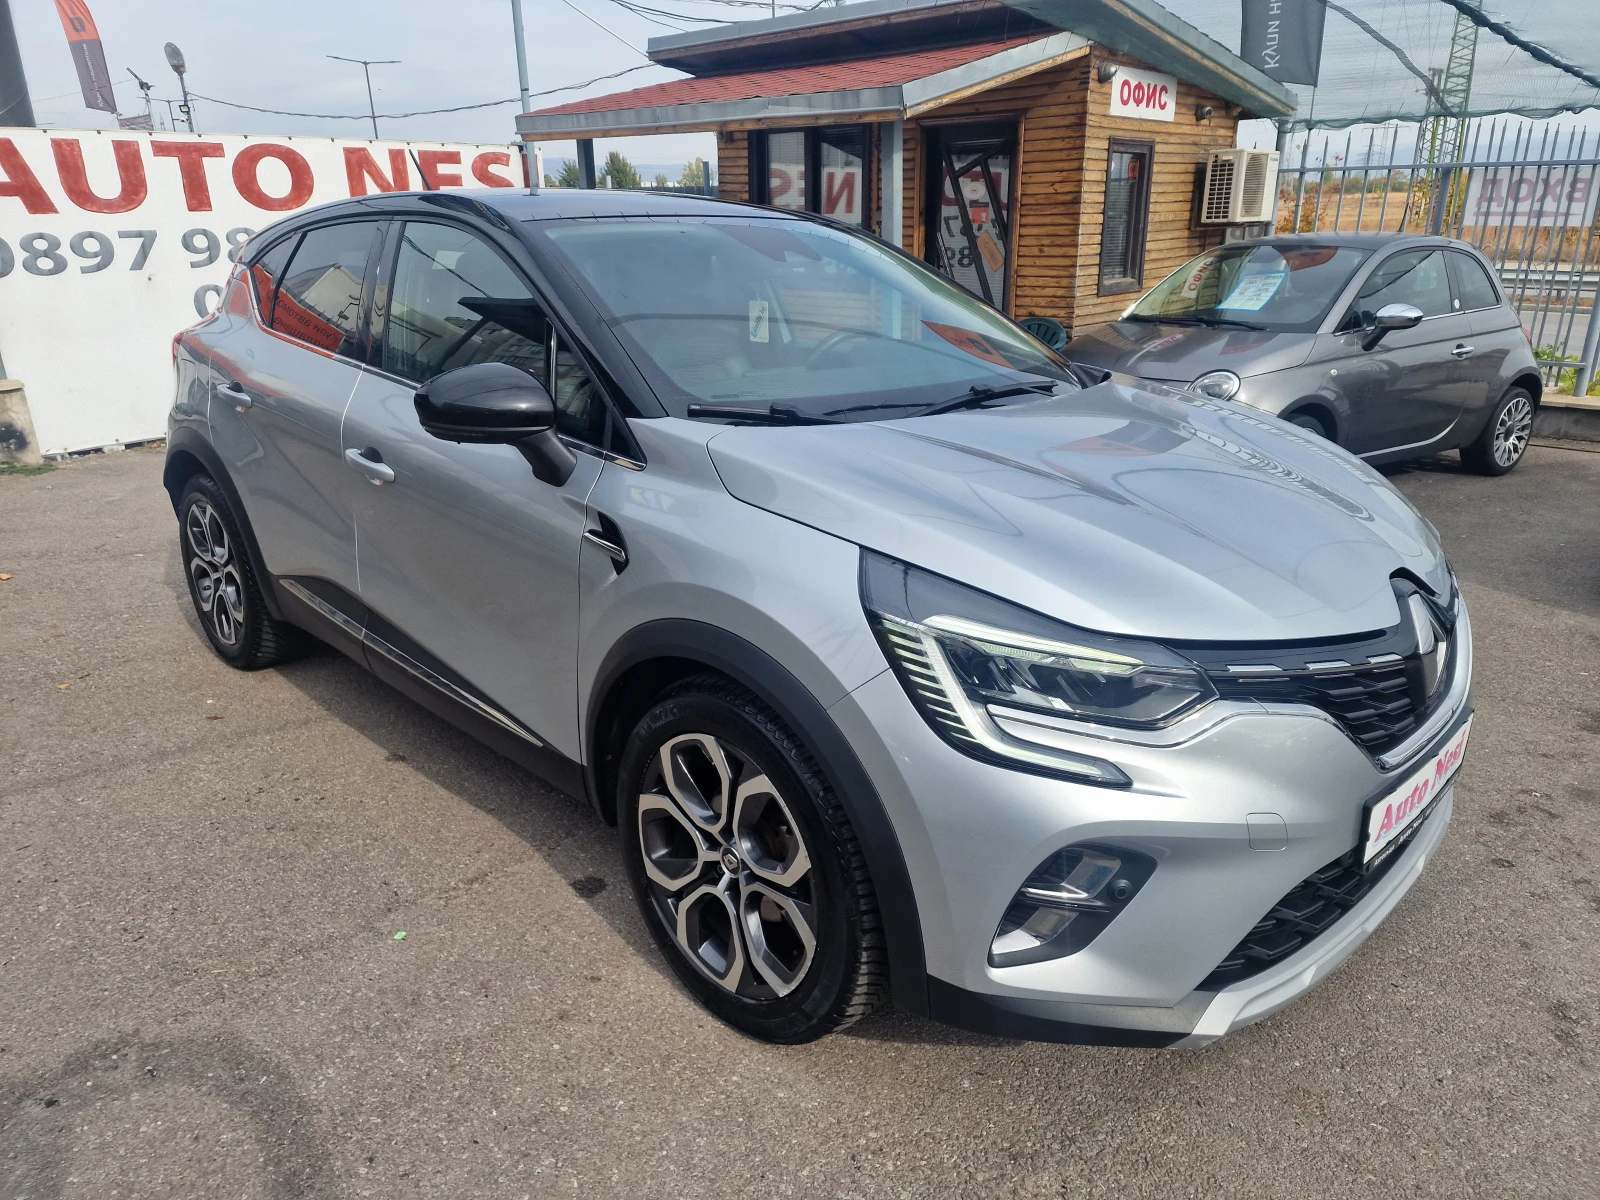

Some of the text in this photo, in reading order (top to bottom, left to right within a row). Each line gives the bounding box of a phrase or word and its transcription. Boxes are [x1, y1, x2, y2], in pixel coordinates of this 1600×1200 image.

[1120, 79, 1168, 110] ОФИС
[0, 137, 315, 214] AUTO
[1373, 778, 1430, 843] Auto
